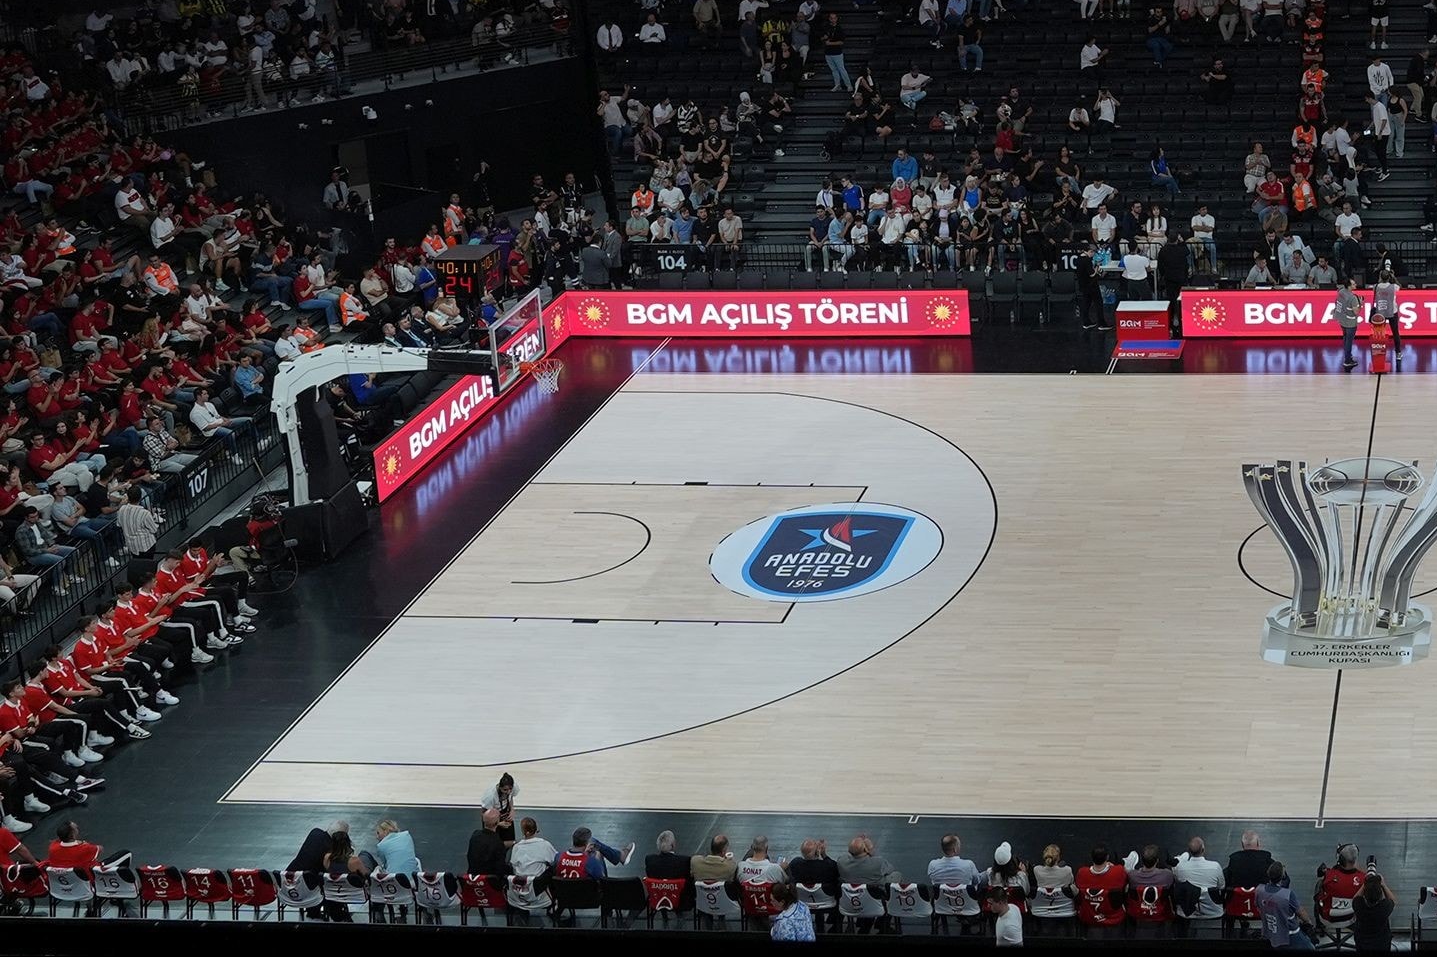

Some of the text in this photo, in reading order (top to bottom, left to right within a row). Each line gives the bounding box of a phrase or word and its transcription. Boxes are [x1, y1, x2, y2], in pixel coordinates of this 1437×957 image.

[436, 261, 478, 276] 40:11
[657, 255, 687, 270] 104
[445, 276, 473, 295] 24
[626, 296, 909, 333] BGM AÇILIŞ TÖRENİ
[1243, 302, 1313, 325] BGM
[1119, 319, 1142, 328] BGM
[408, 409, 447, 460] BGM
[188, 467, 208, 498] 107
[764, 552, 873, 569] ANADOLU
[775, 565, 853, 578] EFES
[786, 579, 824, 589] 1976
[561, 858, 582, 868] SONAT
[742, 867, 763, 876] SONAT
[56, 875, 69, 886] 6
[99, 877, 120, 889] 16
[147, 877, 169, 889] 16
[190, 876, 211, 889] 14
[237, 874, 255, 889] 11
[288, 888, 300, 899] 6
[377, 883, 397, 894] 10
[424, 888, 442, 901] 15
[706, 893, 717, 905] 9
[851, 895, 861, 906] 6
[898, 896, 916, 906] 10
[944, 895, 965, 906] 10
